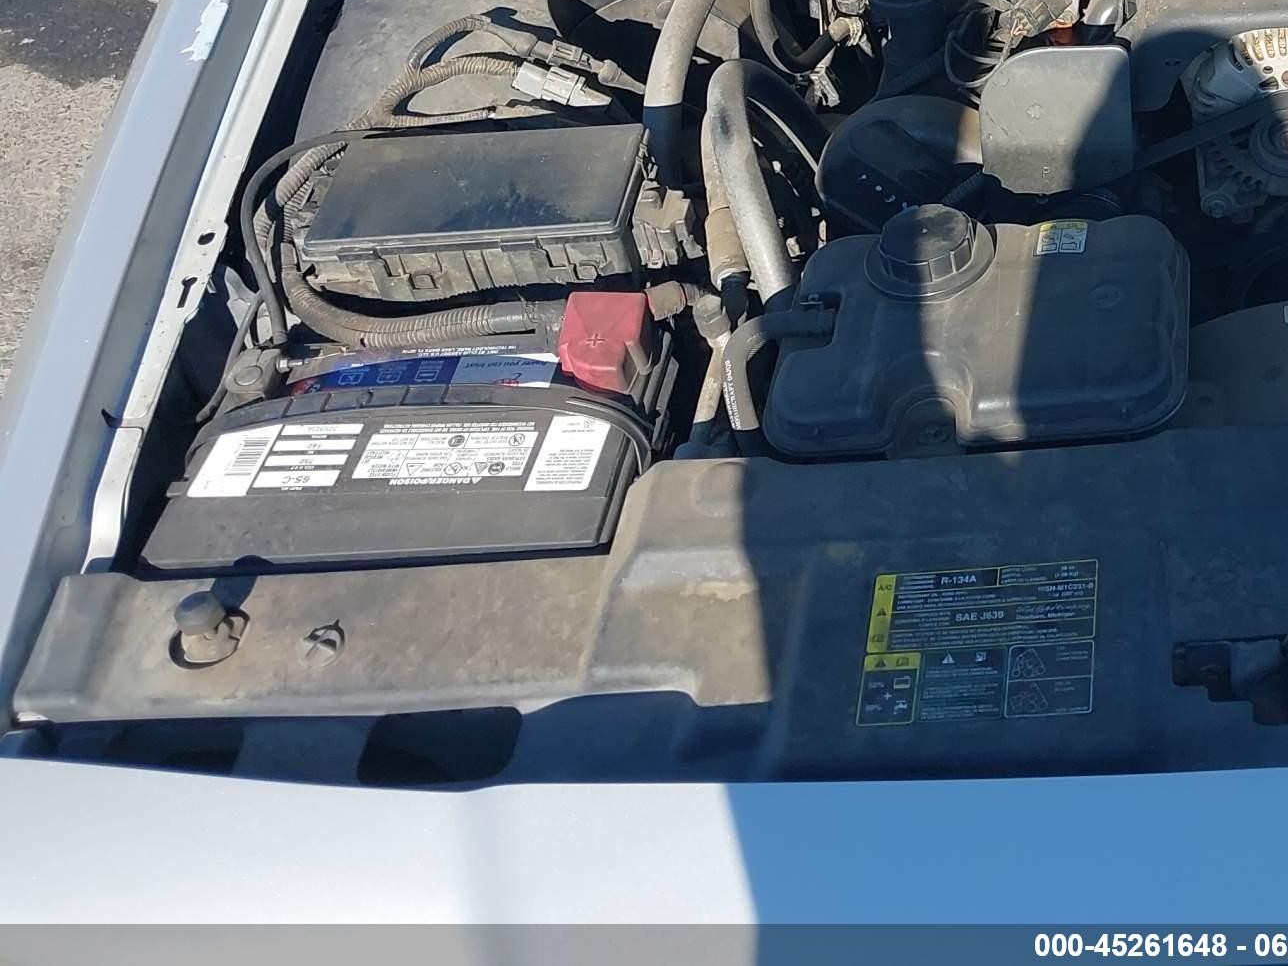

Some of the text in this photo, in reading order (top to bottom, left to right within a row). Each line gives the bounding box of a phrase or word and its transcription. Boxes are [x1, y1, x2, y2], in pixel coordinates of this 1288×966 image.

[281, 475, 310, 484] 65-C
[940, 575, 977, 585] R-134A
[955, 611, 978, 622] SAE
[979, 611, 1005, 620] J639
